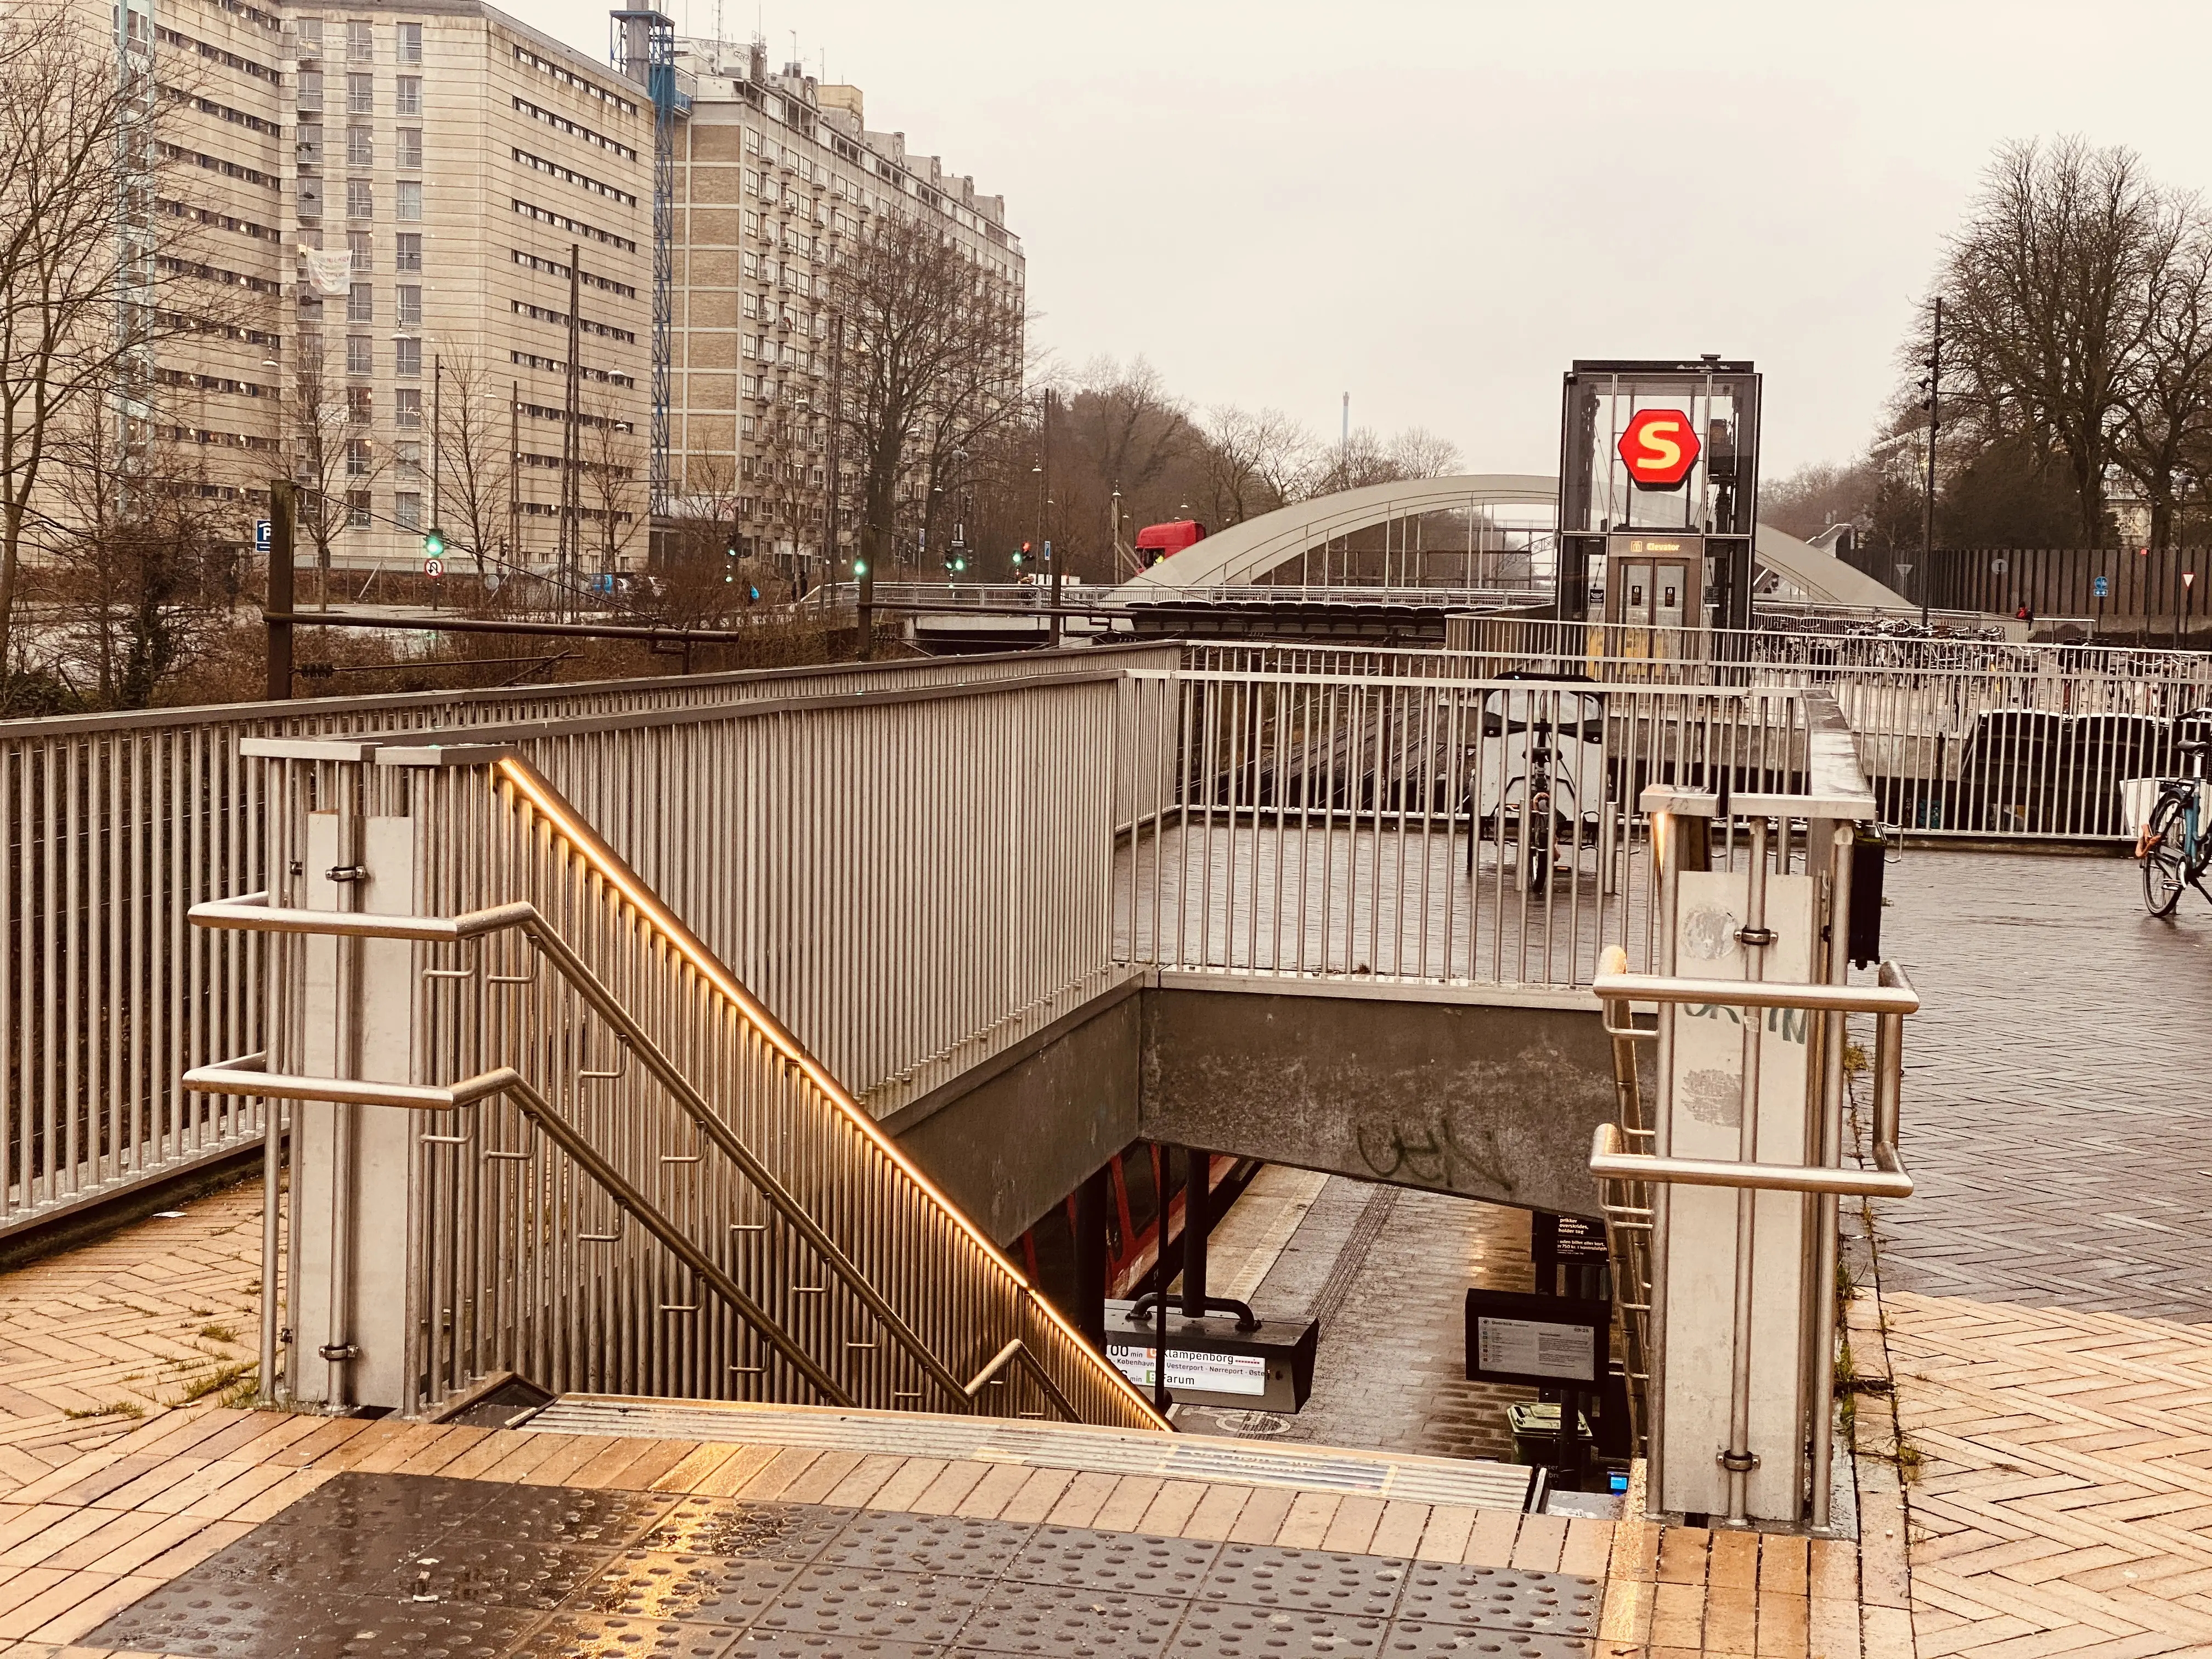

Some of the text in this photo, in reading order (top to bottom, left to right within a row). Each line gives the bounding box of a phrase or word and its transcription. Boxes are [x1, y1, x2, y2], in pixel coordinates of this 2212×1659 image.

[1637, 421, 1681, 470] S
[1117, 1358, 1154, 1367] København
[1166, 1362, 1204, 1372] Vesterport
[1209, 1366, 1243, 1375] Nørreport
